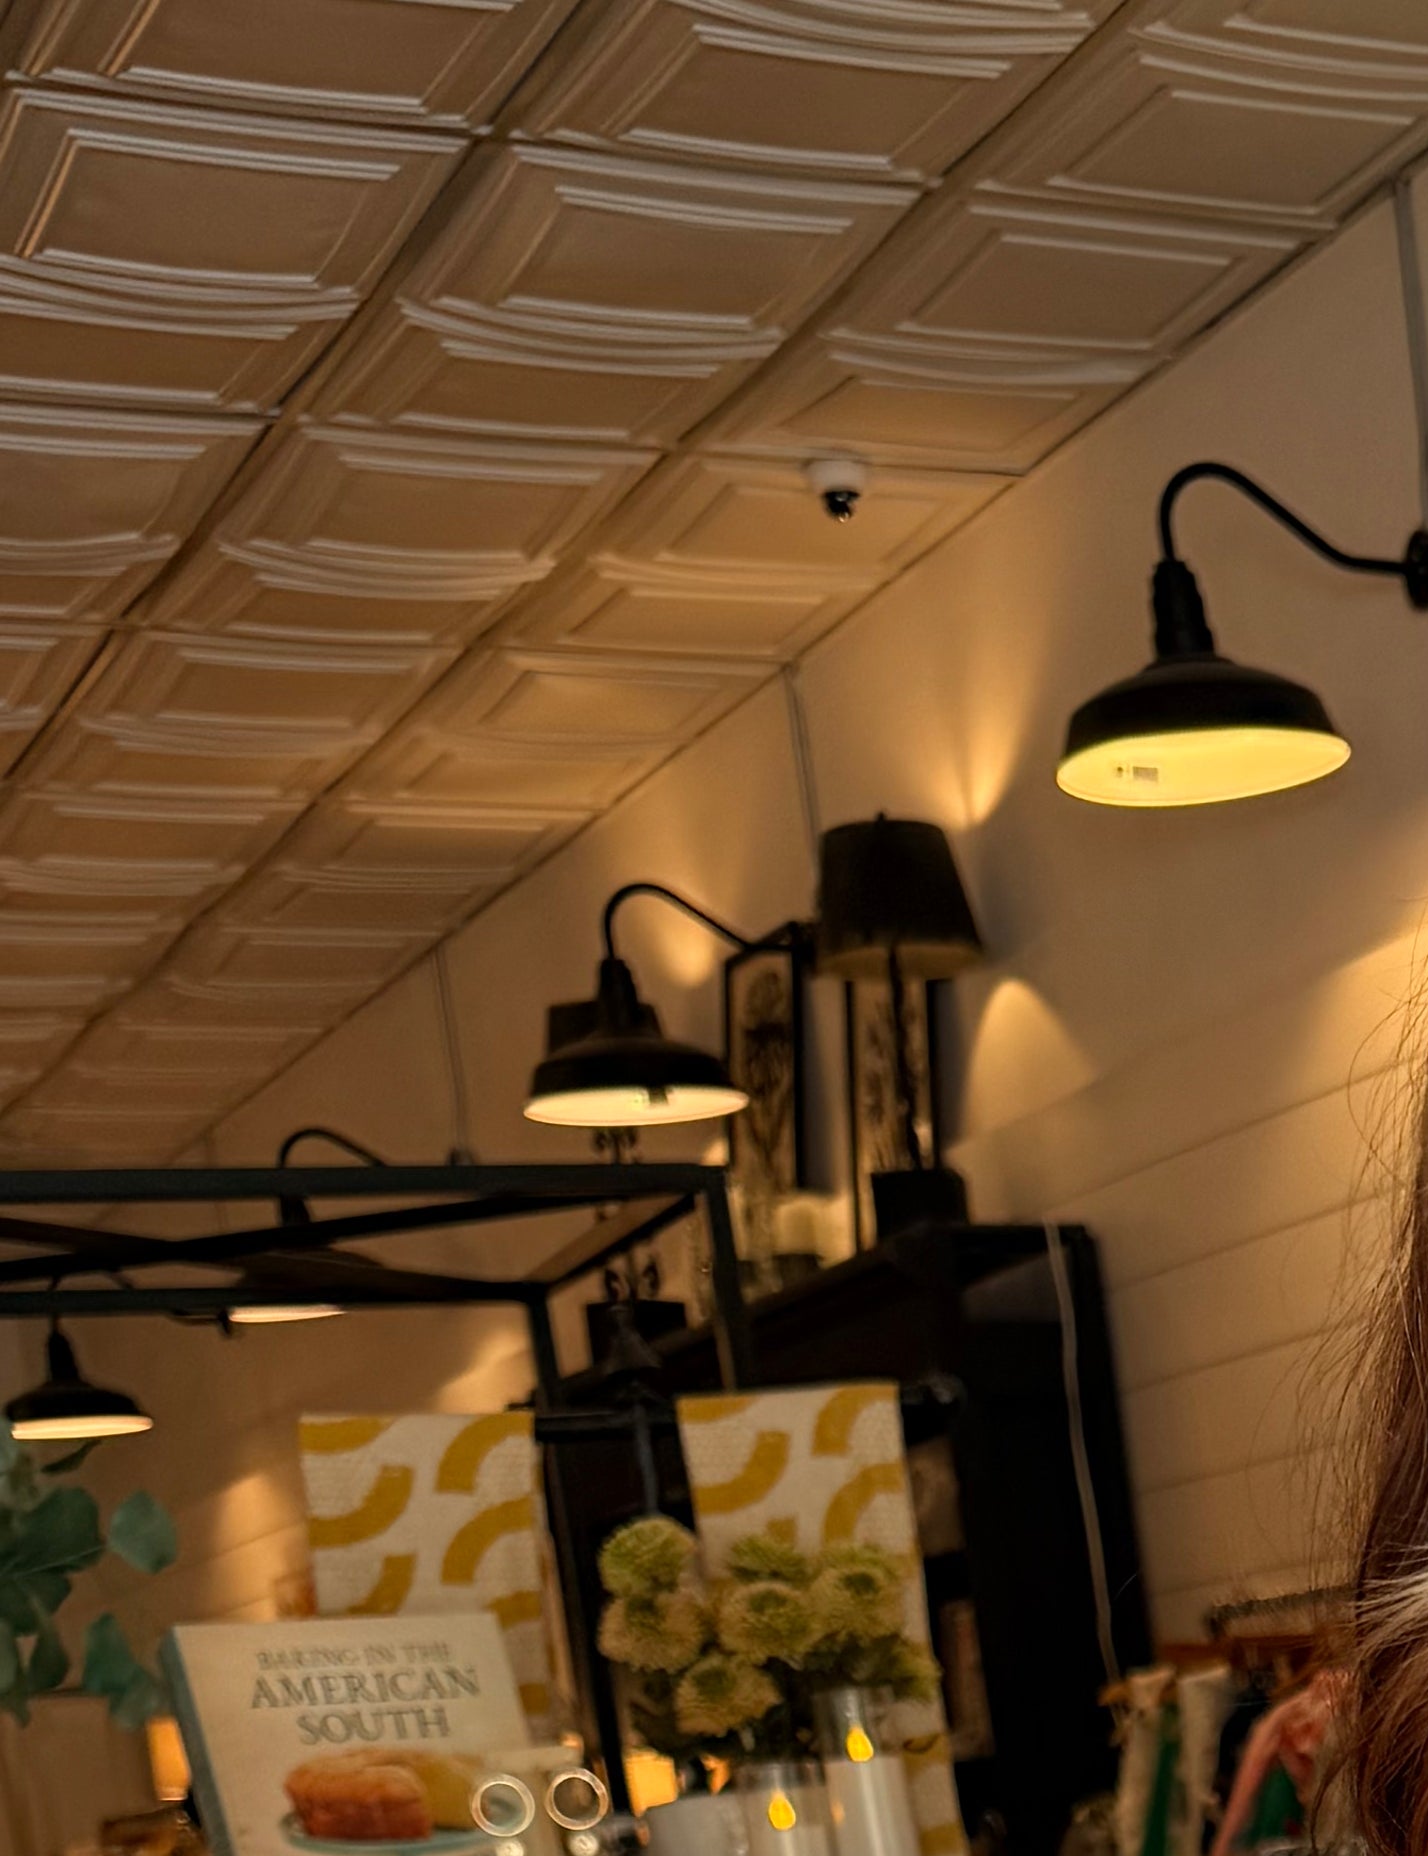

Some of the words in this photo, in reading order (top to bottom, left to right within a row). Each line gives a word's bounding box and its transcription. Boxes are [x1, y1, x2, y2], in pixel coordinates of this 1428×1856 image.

[364, 1644, 397, 1666] IN
[400, 1641, 449, 1663] THE
[251, 1664, 481, 1708] AMERICAN
[297, 1705, 450, 1745] SOUTH
